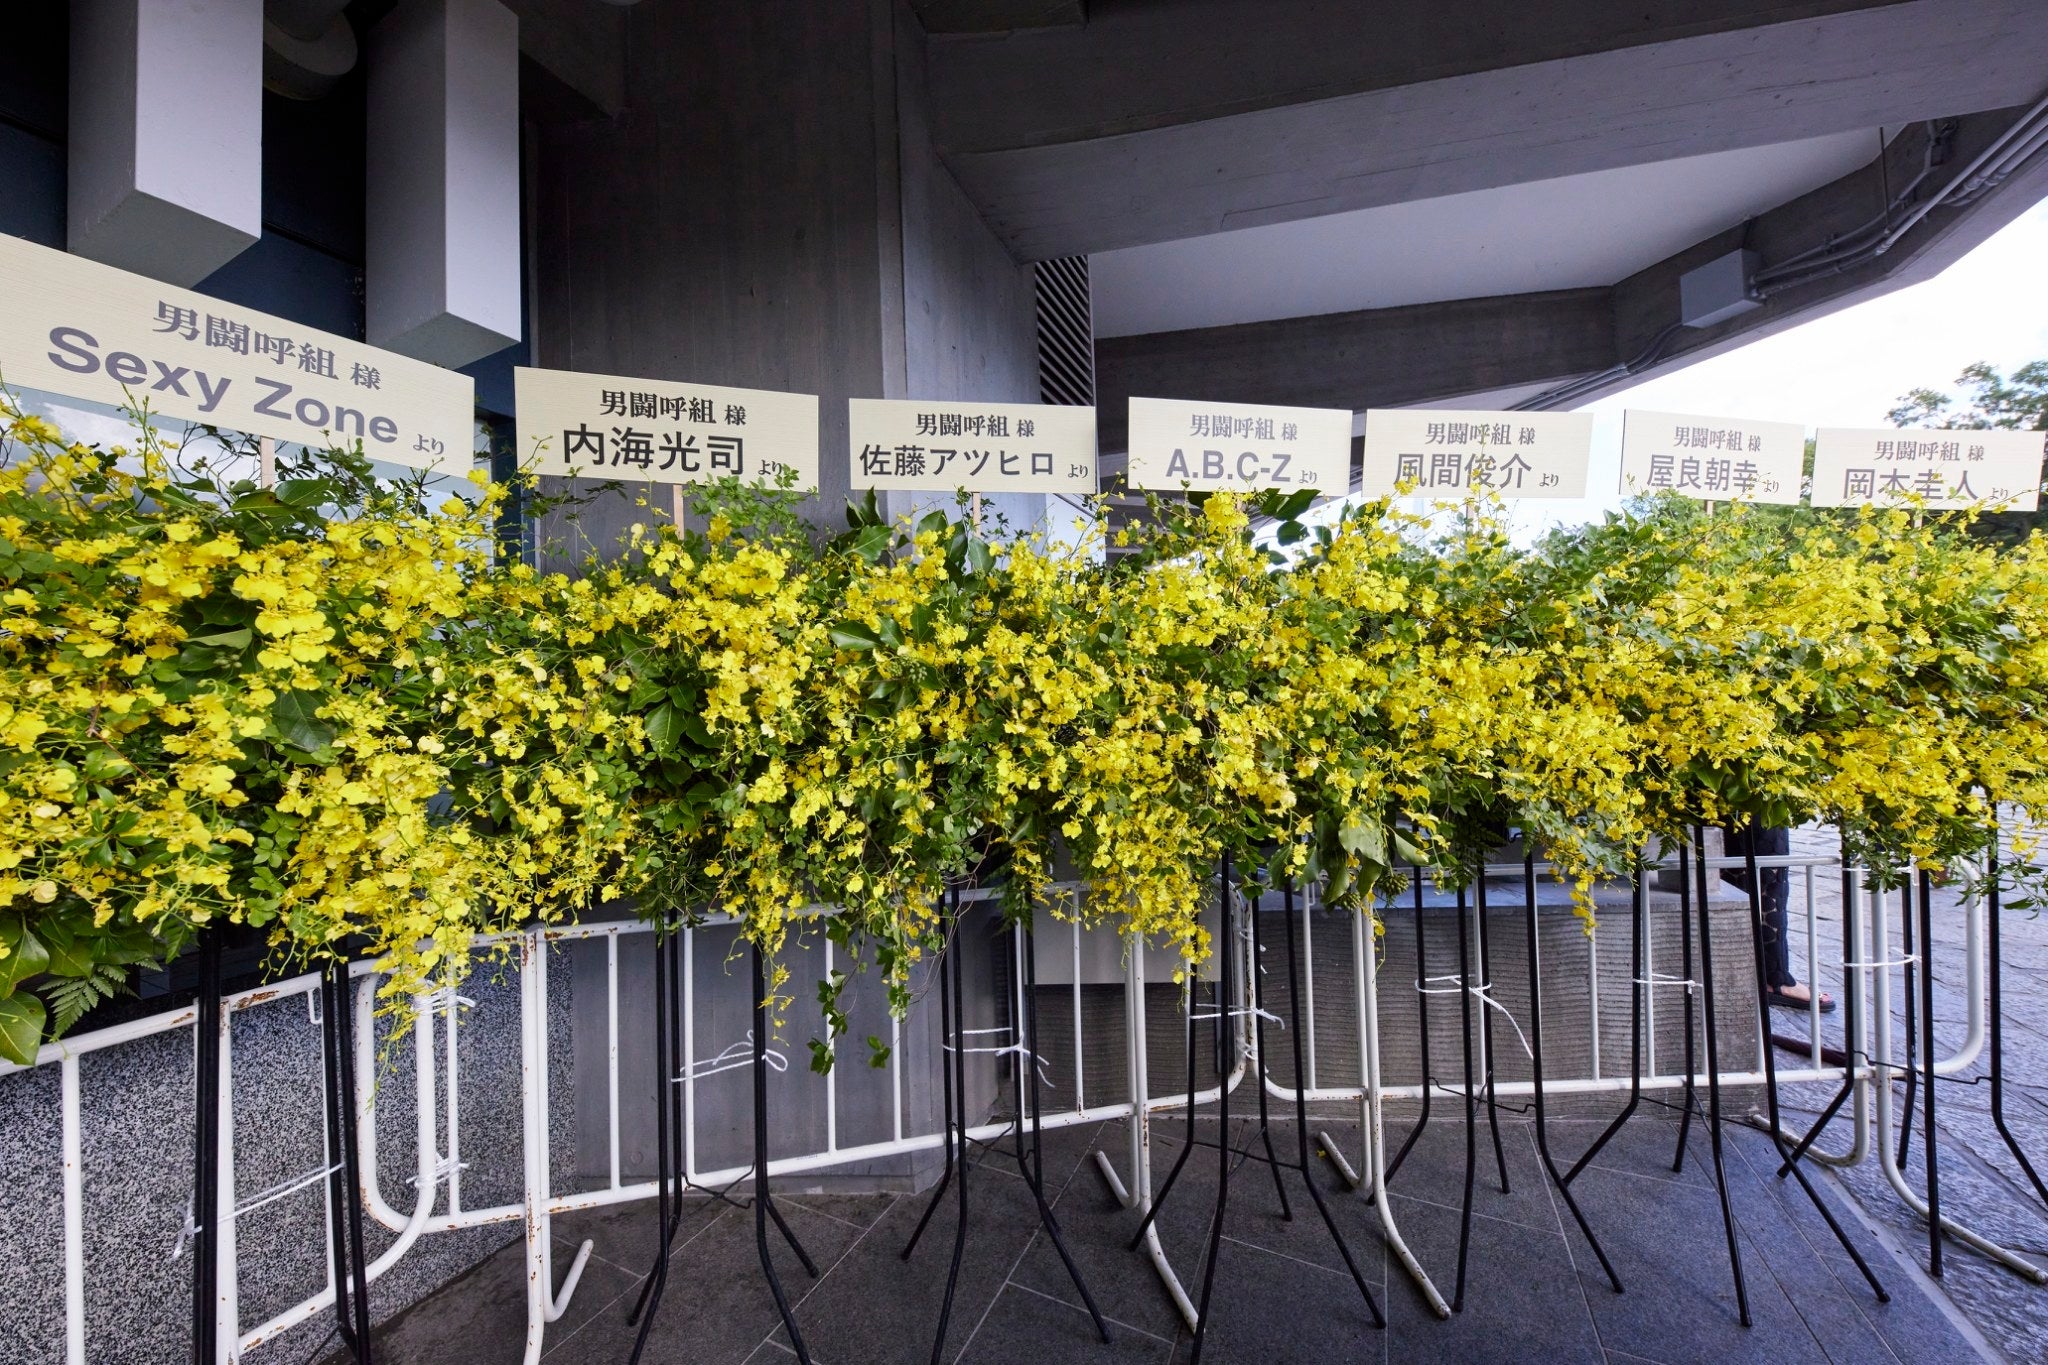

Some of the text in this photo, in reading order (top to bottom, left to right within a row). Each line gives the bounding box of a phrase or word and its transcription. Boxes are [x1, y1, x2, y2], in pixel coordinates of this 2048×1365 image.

[153, 300, 381, 390] 男闘呼組 様
[48, 326, 445, 455] Sexy Zone より
[600, 389, 747, 425] 男闘呼組 様
[915, 413, 1035, 437] 男闘呼組 様
[1189, 414, 1298, 441] 男闘呼組 様
[1425, 422, 1536, 445] 男闘呼組 様
[1673, 426, 1761, 452] 男闘呼組 様
[563, 423, 783, 475] 内海光司 より
[859, 444, 1088, 478] 佐藤アツヒロ より
[1165, 448, 1317, 484] A.B.C-Z より
[1874, 440, 1985, 461] 男闘呼組 様
[1393, 453, 1559, 488] 風間俊介 より
[1646, 454, 1780, 493] 屋良朝幸 より
[1843, 468, 2010, 500] 岡本圭人 より
